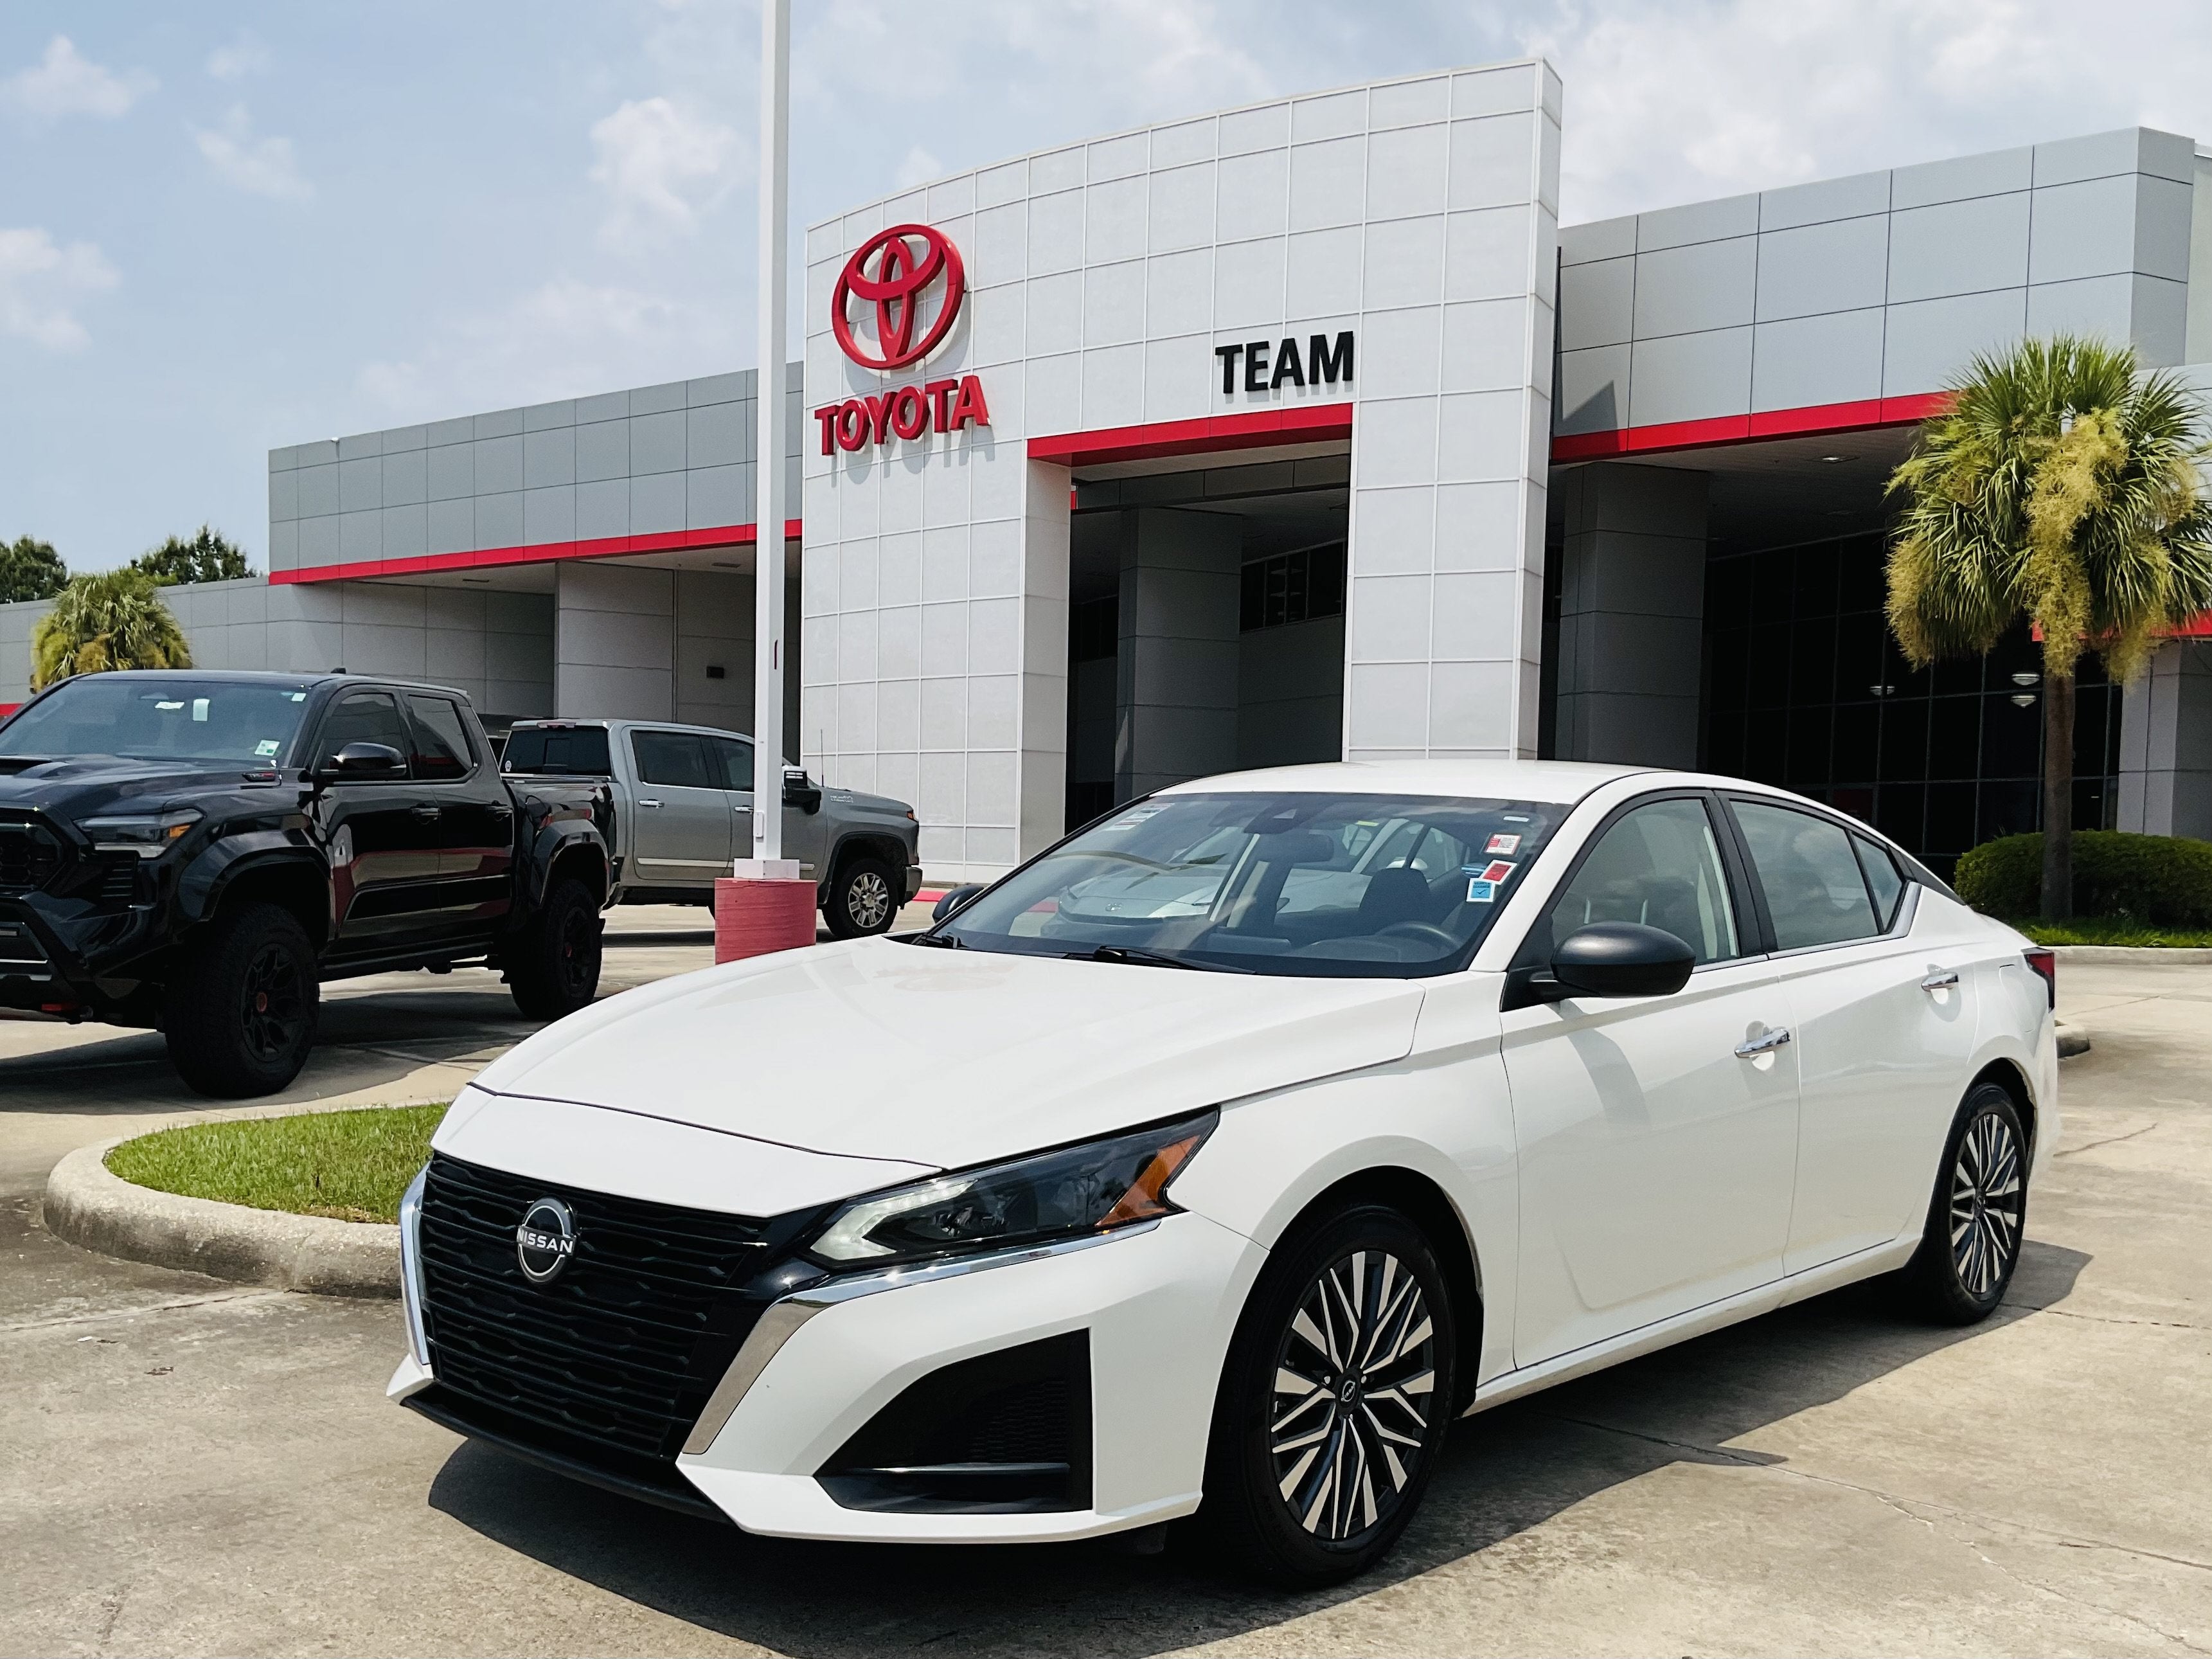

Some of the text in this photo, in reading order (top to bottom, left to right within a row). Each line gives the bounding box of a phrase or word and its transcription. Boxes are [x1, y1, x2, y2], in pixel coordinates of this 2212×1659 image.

[1215, 330, 1353, 394] TEAM
[814, 375, 991, 456] TOYOTA
[517, 1228, 573, 1253] NISSAN
